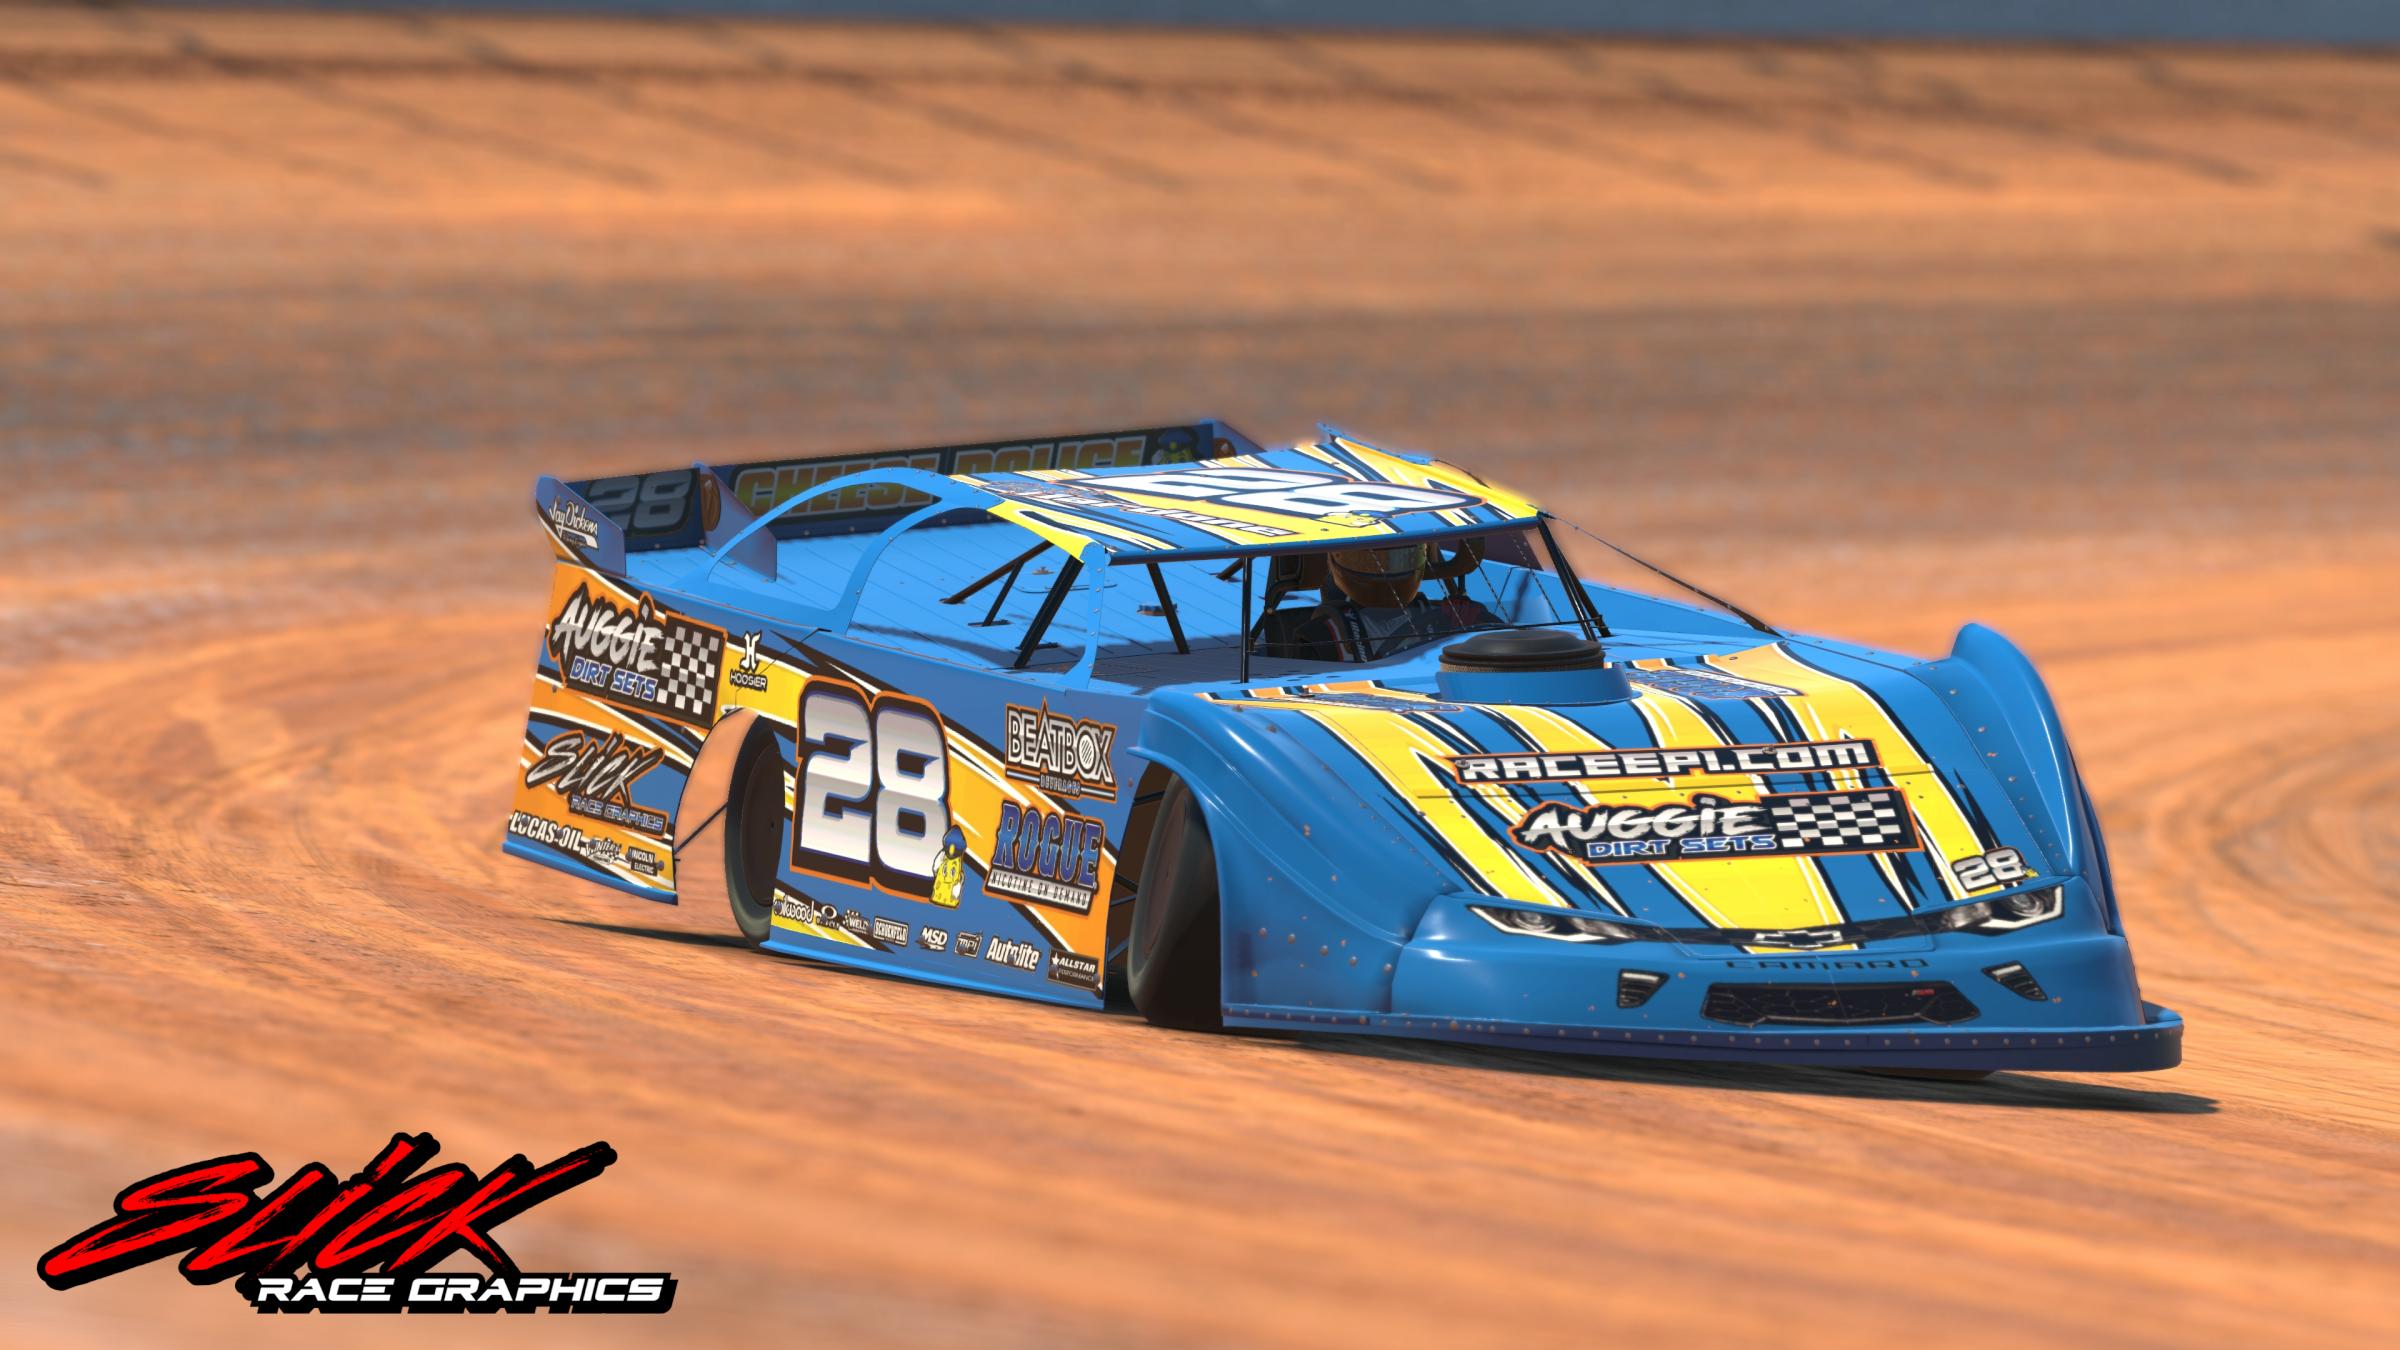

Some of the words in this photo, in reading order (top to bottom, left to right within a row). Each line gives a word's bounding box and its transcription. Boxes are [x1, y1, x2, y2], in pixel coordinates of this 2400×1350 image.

[588, 470, 693, 531] 28
[569, 656, 612, 688] DIRT
[610, 669, 658, 702] SETS
[730, 670, 768, 690] HOOSIER
[1008, 709, 1114, 783] BEATBOX
[1463, 742, 1870, 780] RACEEPI.COM
[799, 689, 949, 879] 28
[571, 794, 604, 816] RACE
[603, 803, 664, 831] GRAPHICS
[509, 811, 558, 844] LUCAS
[558, 826, 583, 852] OIL
[992, 802, 1100, 889] ROGUE
[1587, 839, 1671, 858] DIRT
[1680, 834, 1777, 854] SETS
[1952, 848, 2025, 890] 28
[991, 871, 1033, 893] NICOTINE
[1037, 882, 1049, 896] ON
[1052, 885, 1088, 907] DEMAND
[922, 926, 948, 946] MSD
[986, 937, 1040, 970] Autolite
[1059, 957, 1096, 973] ALLSTAR
[1726, 958, 1930, 971] CAMARO
